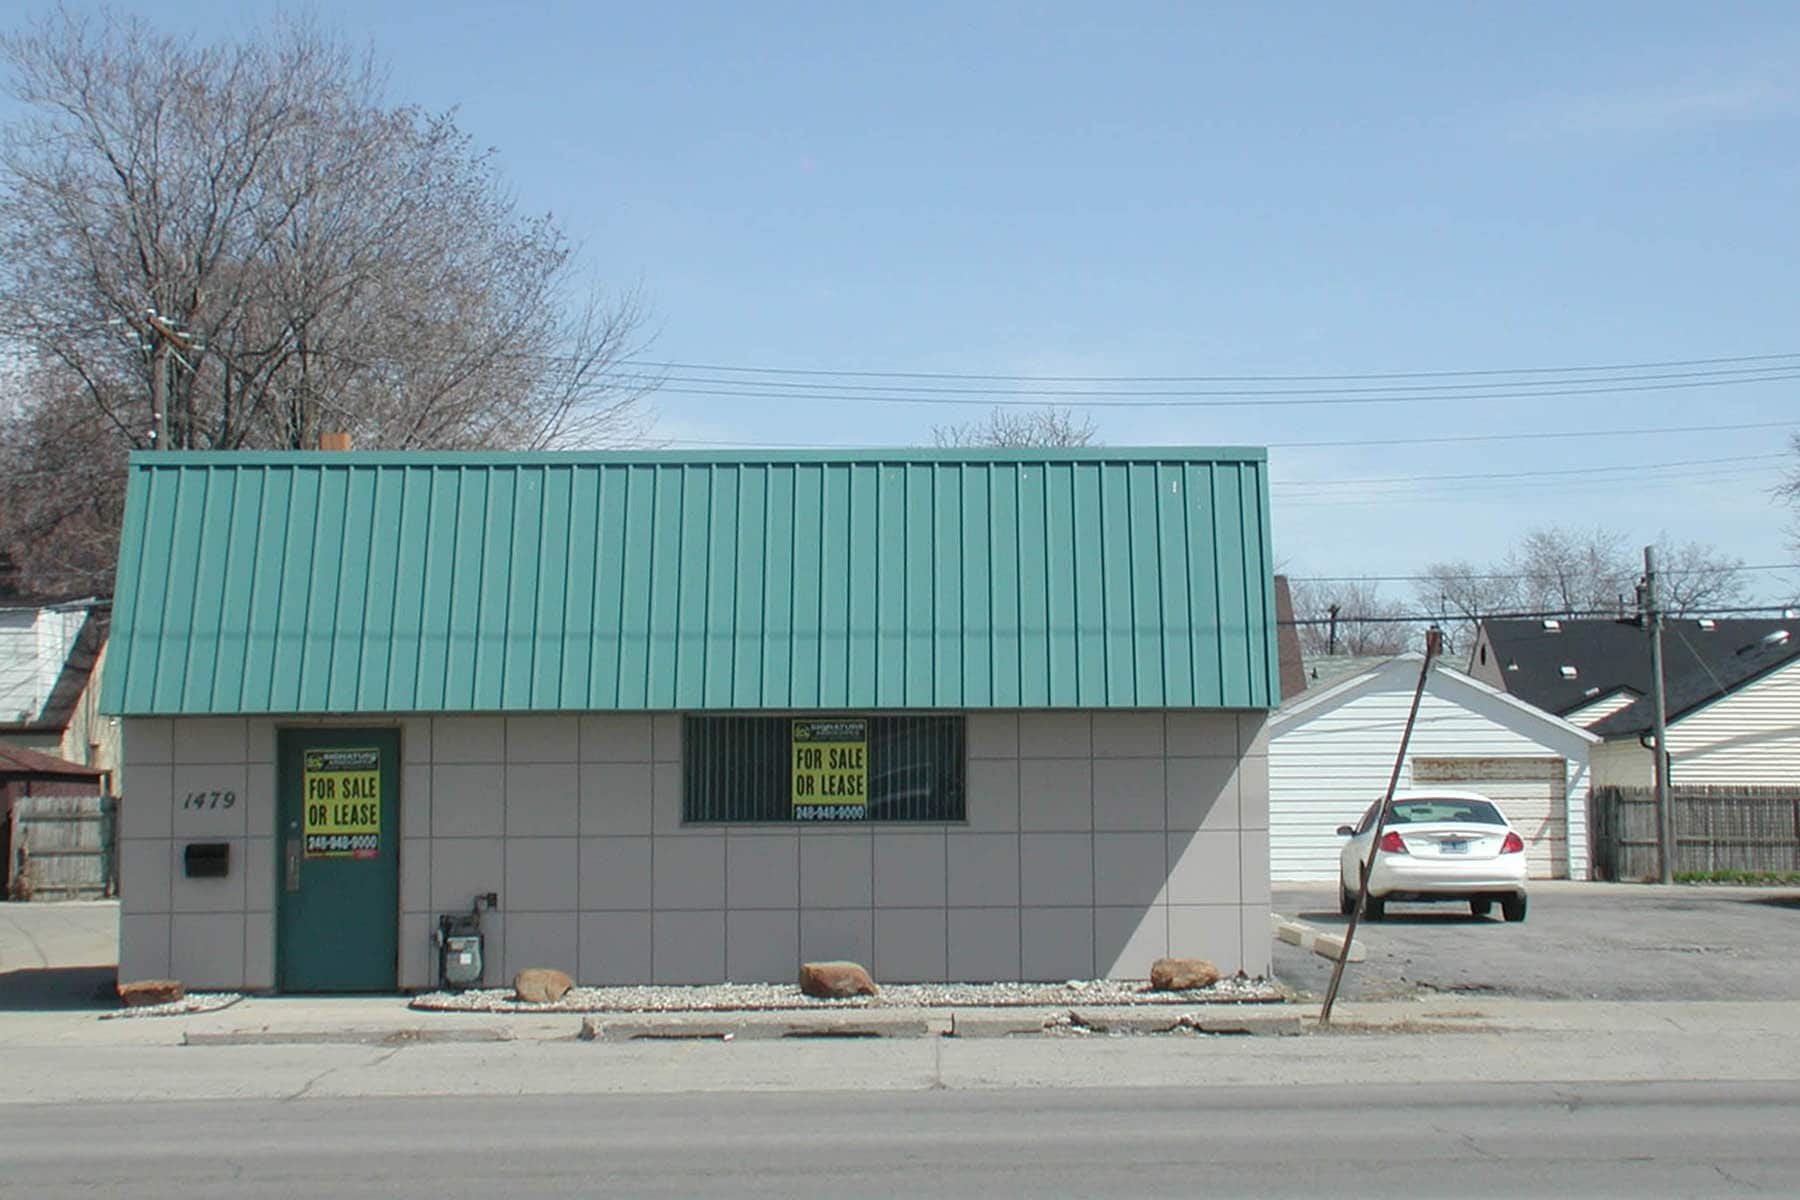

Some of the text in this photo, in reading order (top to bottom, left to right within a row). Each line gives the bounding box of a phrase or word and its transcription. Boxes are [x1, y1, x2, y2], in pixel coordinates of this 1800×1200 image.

[797, 748, 864, 769] FOR SALE
[309, 777, 377, 799] FOR SALE
[796, 774, 864, 796] OR LEASE
[184, 791, 236, 809] 1479
[309, 804, 377, 825] OR LEASE
